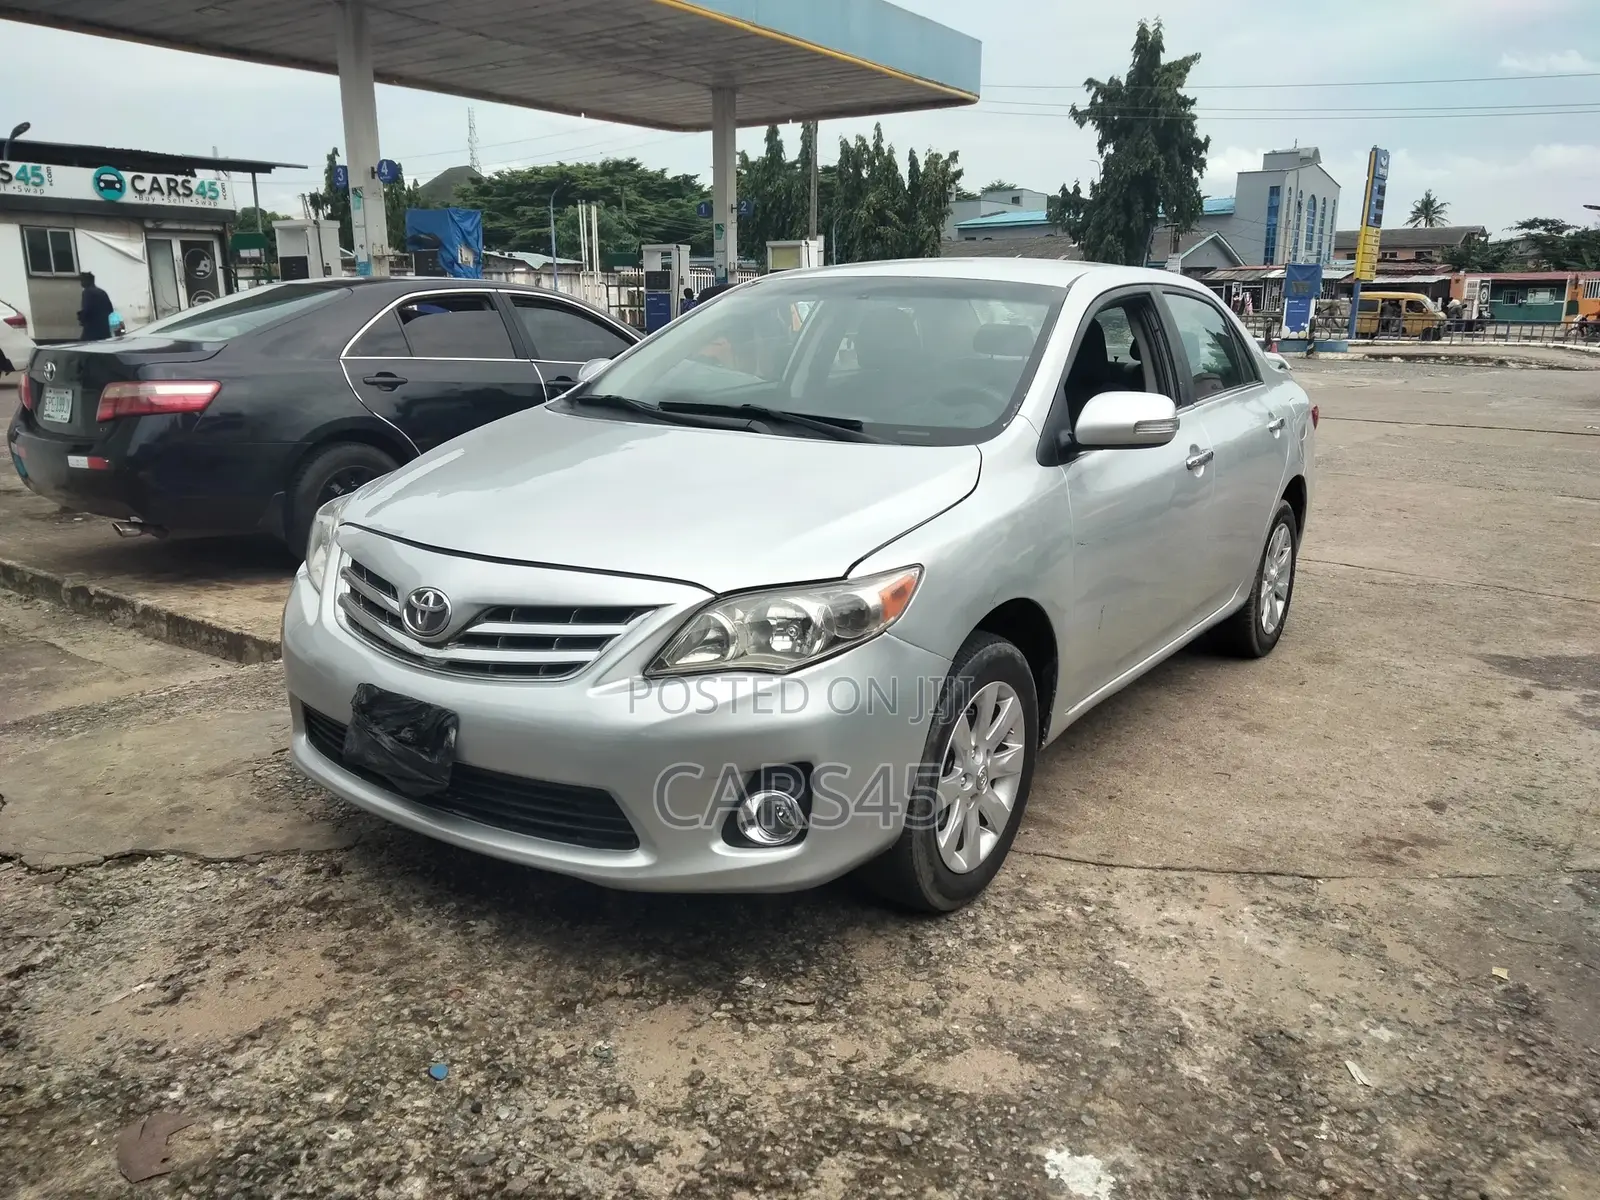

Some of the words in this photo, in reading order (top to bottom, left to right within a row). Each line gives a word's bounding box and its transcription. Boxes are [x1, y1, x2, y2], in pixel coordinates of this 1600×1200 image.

[381, 161, 388, 175] 4
[337, 168, 344, 181] 3
[130, 174, 220, 201] CARS45
[195, 198, 218, 207] Swap
[740, 201, 747, 211] 2
[700, 204, 705, 214] 1
